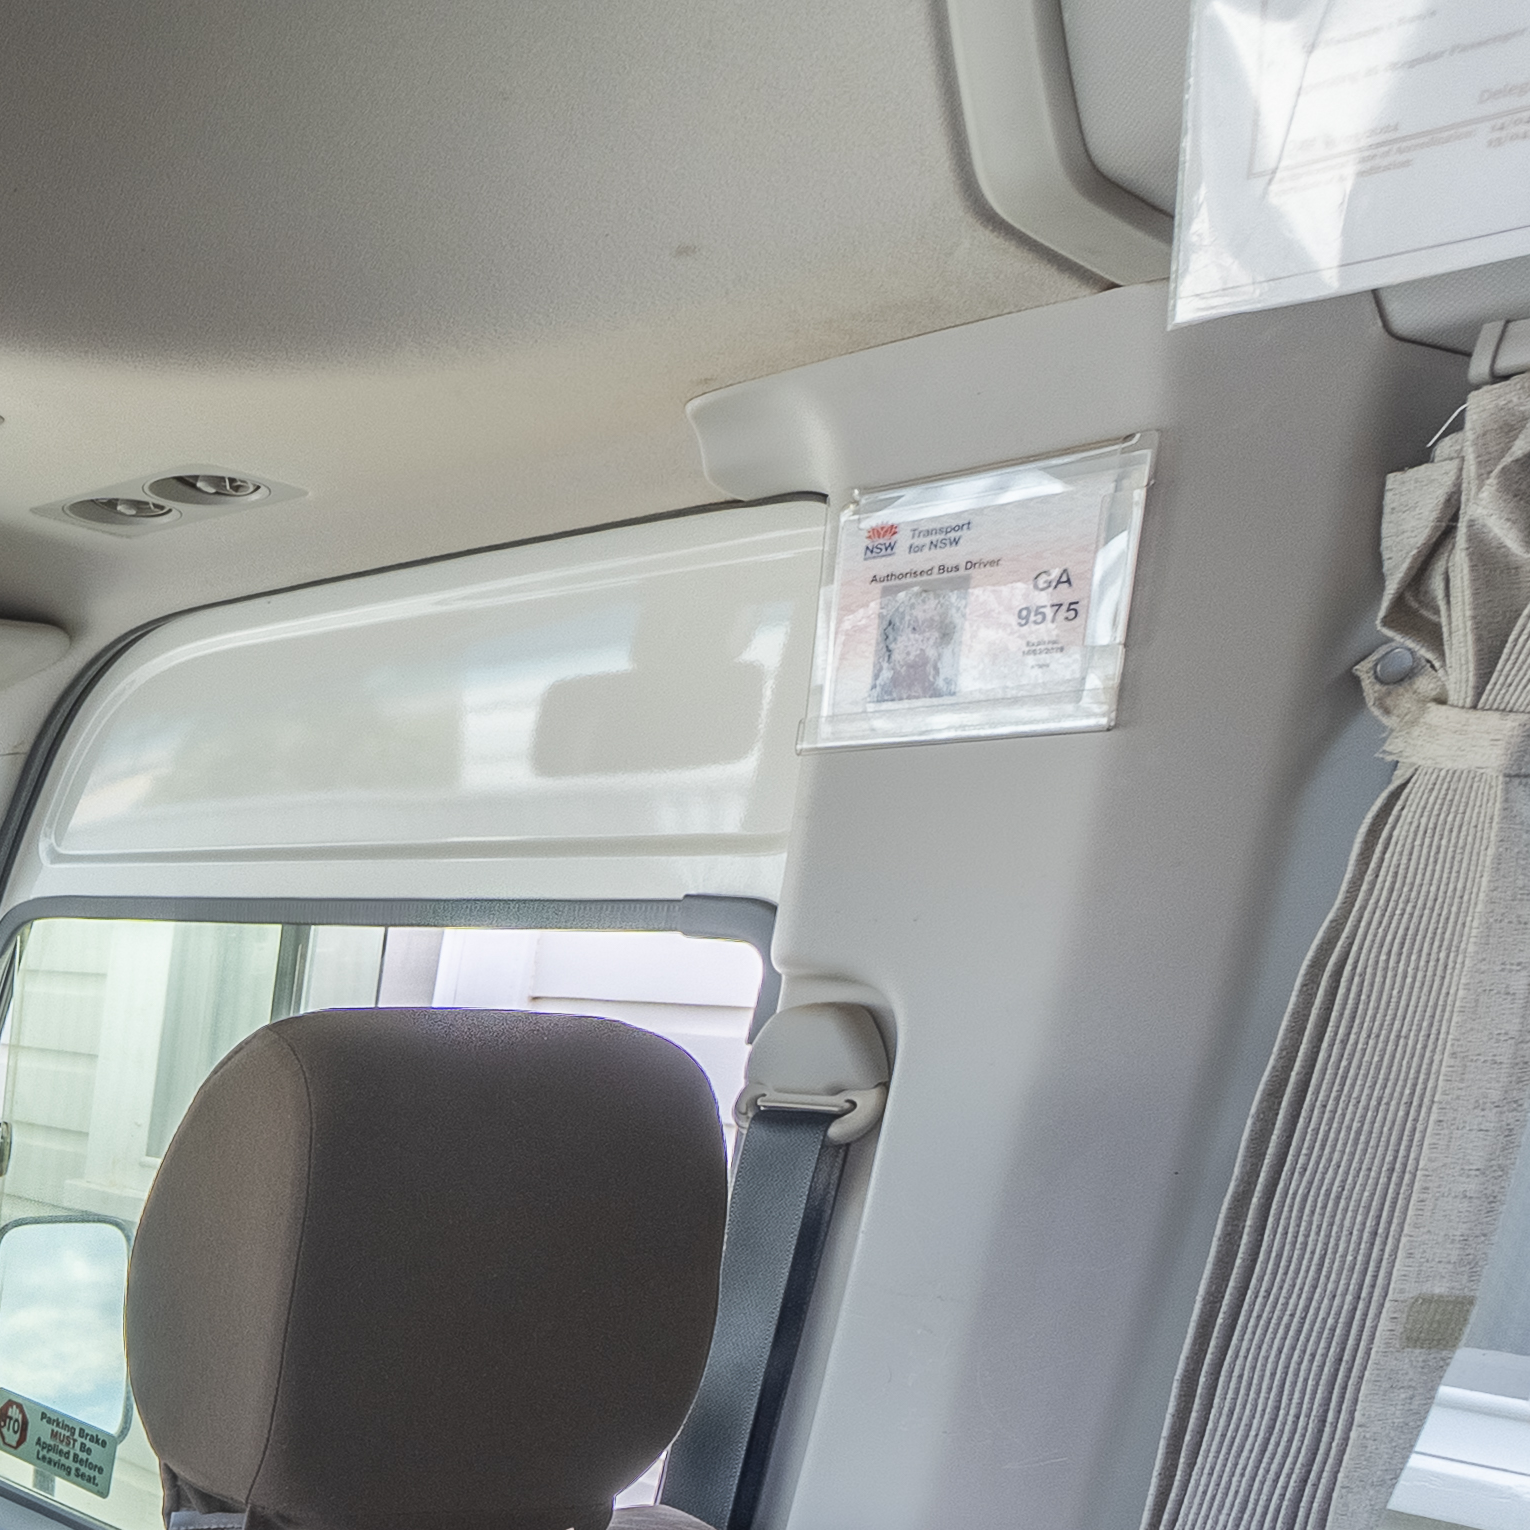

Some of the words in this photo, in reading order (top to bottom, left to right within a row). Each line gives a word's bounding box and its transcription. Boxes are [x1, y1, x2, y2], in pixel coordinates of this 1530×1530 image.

[910, 520, 972, 539] Transport
[864, 541, 896, 556] NSW
[908, 543, 926, 555] for
[928, 535, 962, 551] NSW
[869, 566, 935, 585] Authorised
[938, 564, 960, 574] Bus
[964, 557, 1002, 571] Driver
[1033, 568, 1072, 591] GA
[1017, 601, 1079, 627] 9575
[40, 1411, 76, 1437] Parking
[78, 1427, 107, 1448] Brake
[50, 1429, 78, 1449] MUST
[79, 1441, 92, 1456] Be
[35, 1436, 71, 1460] Applied
[72, 1453, 104, 1475] Before
[36, 1450, 72, 1476] Leaving
[74, 1467, 99, 1487] Seat.
